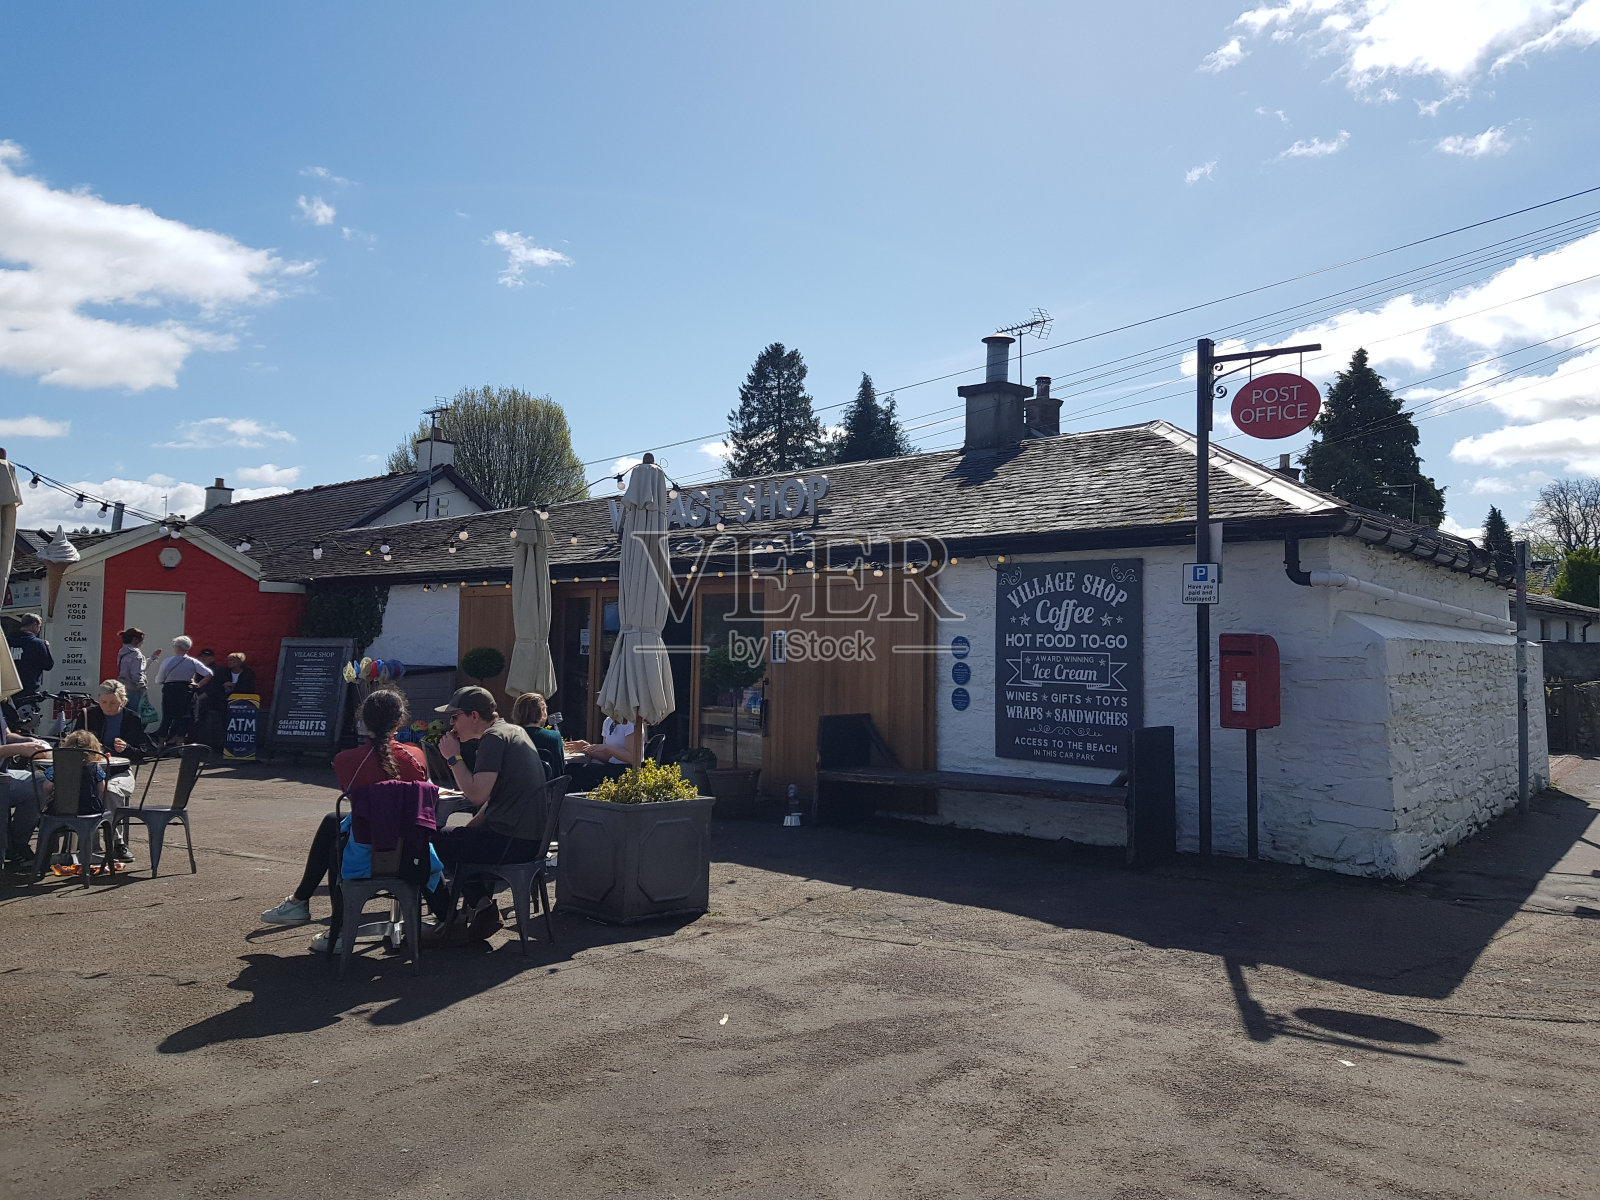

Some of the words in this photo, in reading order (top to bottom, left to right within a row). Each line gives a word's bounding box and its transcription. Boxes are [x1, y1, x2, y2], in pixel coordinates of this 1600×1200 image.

[1252, 385, 1302, 404] POST
[1240, 403, 1308, 423] OFFICE
[608, 487, 725, 533] VAGE
[736, 475, 830, 524] SHOP
[1196, 567, 1206, 580] P
[1006, 571, 1076, 609] VILLAGE
[1082, 573, 1128, 609] SHOP
[1035, 599, 1095, 632] Coffee
[1005, 633, 1033, 648] HOT
[1036, 633, 1076, 648] FOOD
[1081, 634, 1128, 649] TO-GO
[1035, 655, 1061, 663] AWARD
[1063, 656, 1095, 664] WINNING
[1032, 664, 1051, 680] Ice
[1054, 664, 1098, 682] Cream
[1005, 690, 1038, 702] WINES
[1051, 692, 1082, 705] GIFTS
[1095, 694, 1128, 708] TOYS
[227, 718, 256, 732] ATM
[1006, 705, 1043, 721] WRAPS
[1054, 706, 1128, 727] SANDWICHES
[299, 720, 327, 731] GIFTS
[226, 733, 255, 743] INSIDE
[1014, 736, 1049, 747] ACCESS
[1052, 738, 1063, 748] TO
[1066, 740, 1083, 750] THE
[1086, 741, 1118, 754] BEACH
[1033, 749, 1041, 757] IN
[1042, 749, 1058, 758] THIS
[1059, 751, 1074, 760] CAR
[1076, 752, 1095, 761] PARK
